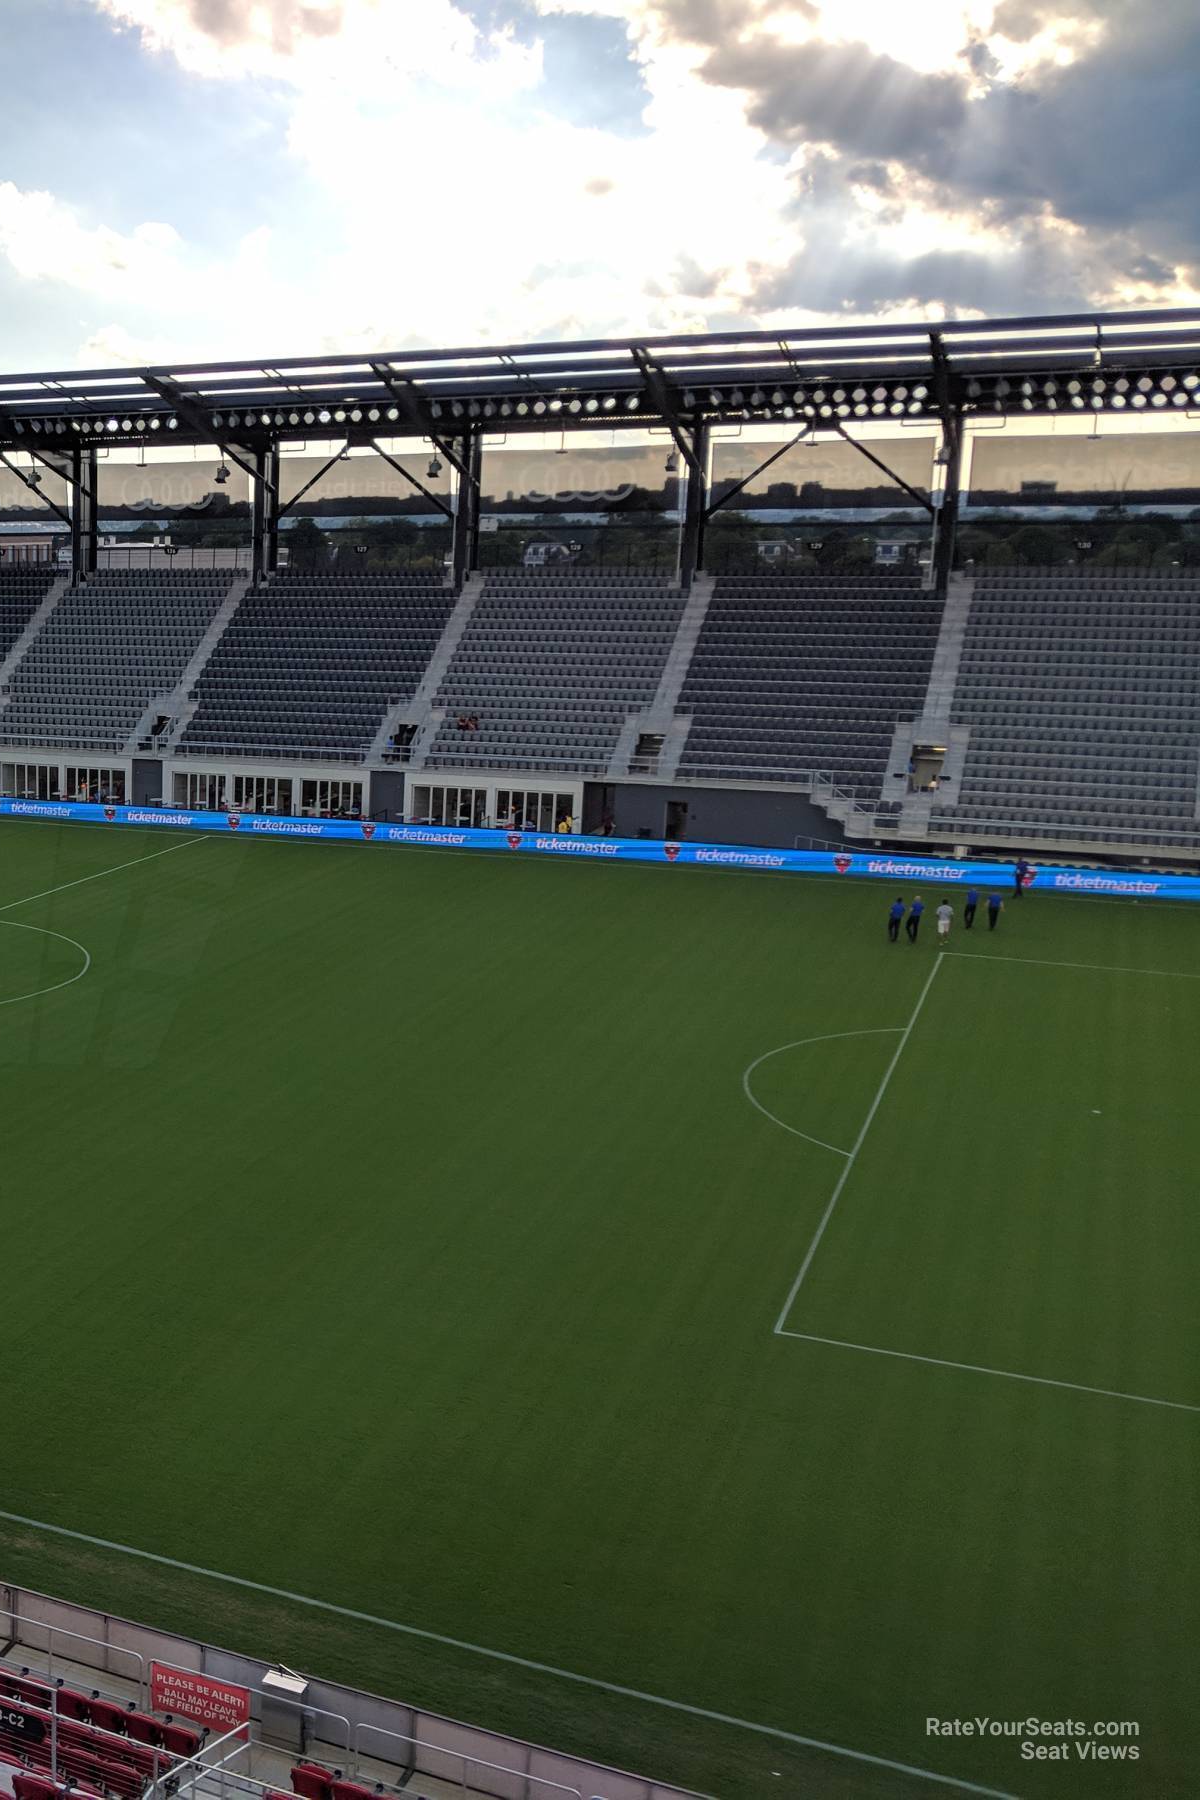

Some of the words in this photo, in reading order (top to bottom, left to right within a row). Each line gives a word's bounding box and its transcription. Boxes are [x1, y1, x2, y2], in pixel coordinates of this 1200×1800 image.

[11, 802, 72, 818] ticketmaster
[127, 810, 193, 825] ticketmaster
[252, 819, 323, 834] ticketmaster
[389, 828, 465, 844] ticketmaster
[536, 837, 620, 855] ticketmaster
[696, 848, 786, 866] ticketmaster
[868, 860, 967, 879] ticketmaster
[1055, 872, 1160, 893] ticketmaster
[156, 1673, 194, 1690] PLEASE
[196, 1685, 210, 1696] BE
[211, 1690, 245, 1709] ALERT!
[157, 1695, 175, 1706] THE
[176, 1701, 202, 1715] FIELD
[203, 1710, 218, 1720] OF
[164, 1688, 186, 1701] BALL
[187, 1695, 208, 1708] MAY
[209, 1702, 237, 1717] LEAVE
